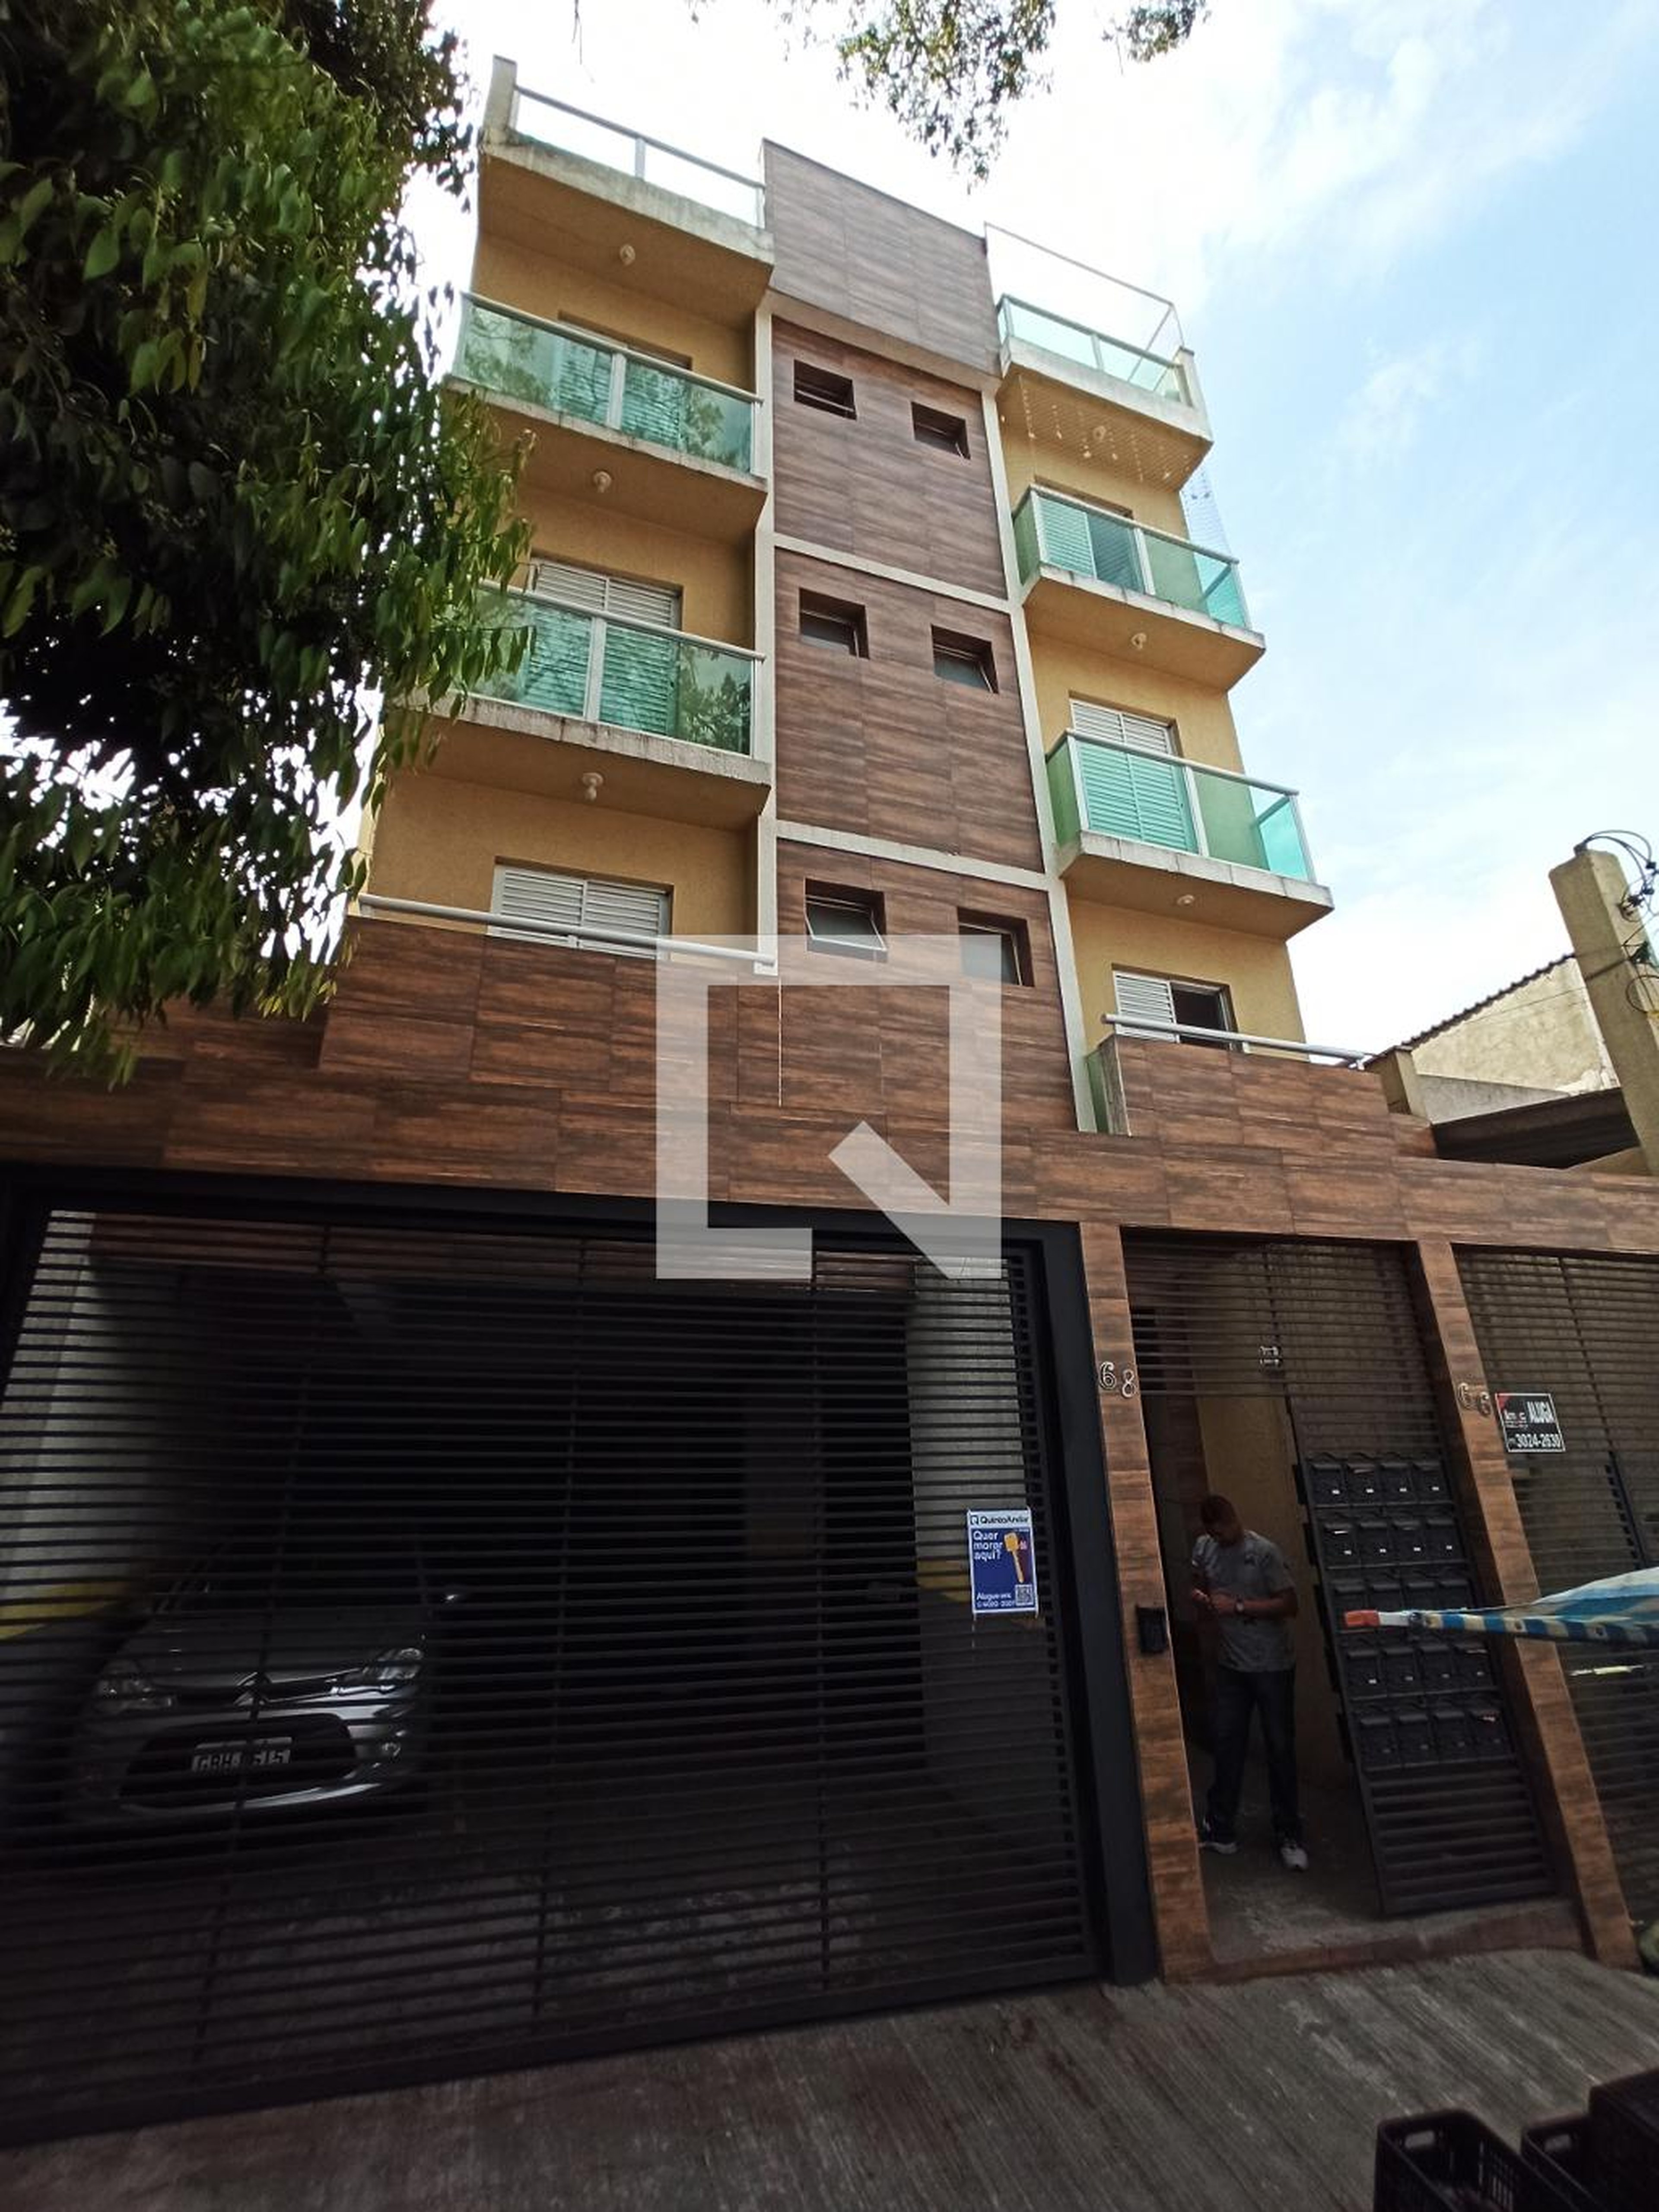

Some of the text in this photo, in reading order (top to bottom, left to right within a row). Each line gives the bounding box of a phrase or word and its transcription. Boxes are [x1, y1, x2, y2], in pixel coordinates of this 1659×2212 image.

[1100, 1361, 1136, 1398] 68
[973, 1531, 998, 1540] Quer
[973, 1541, 1003, 1550] morar
